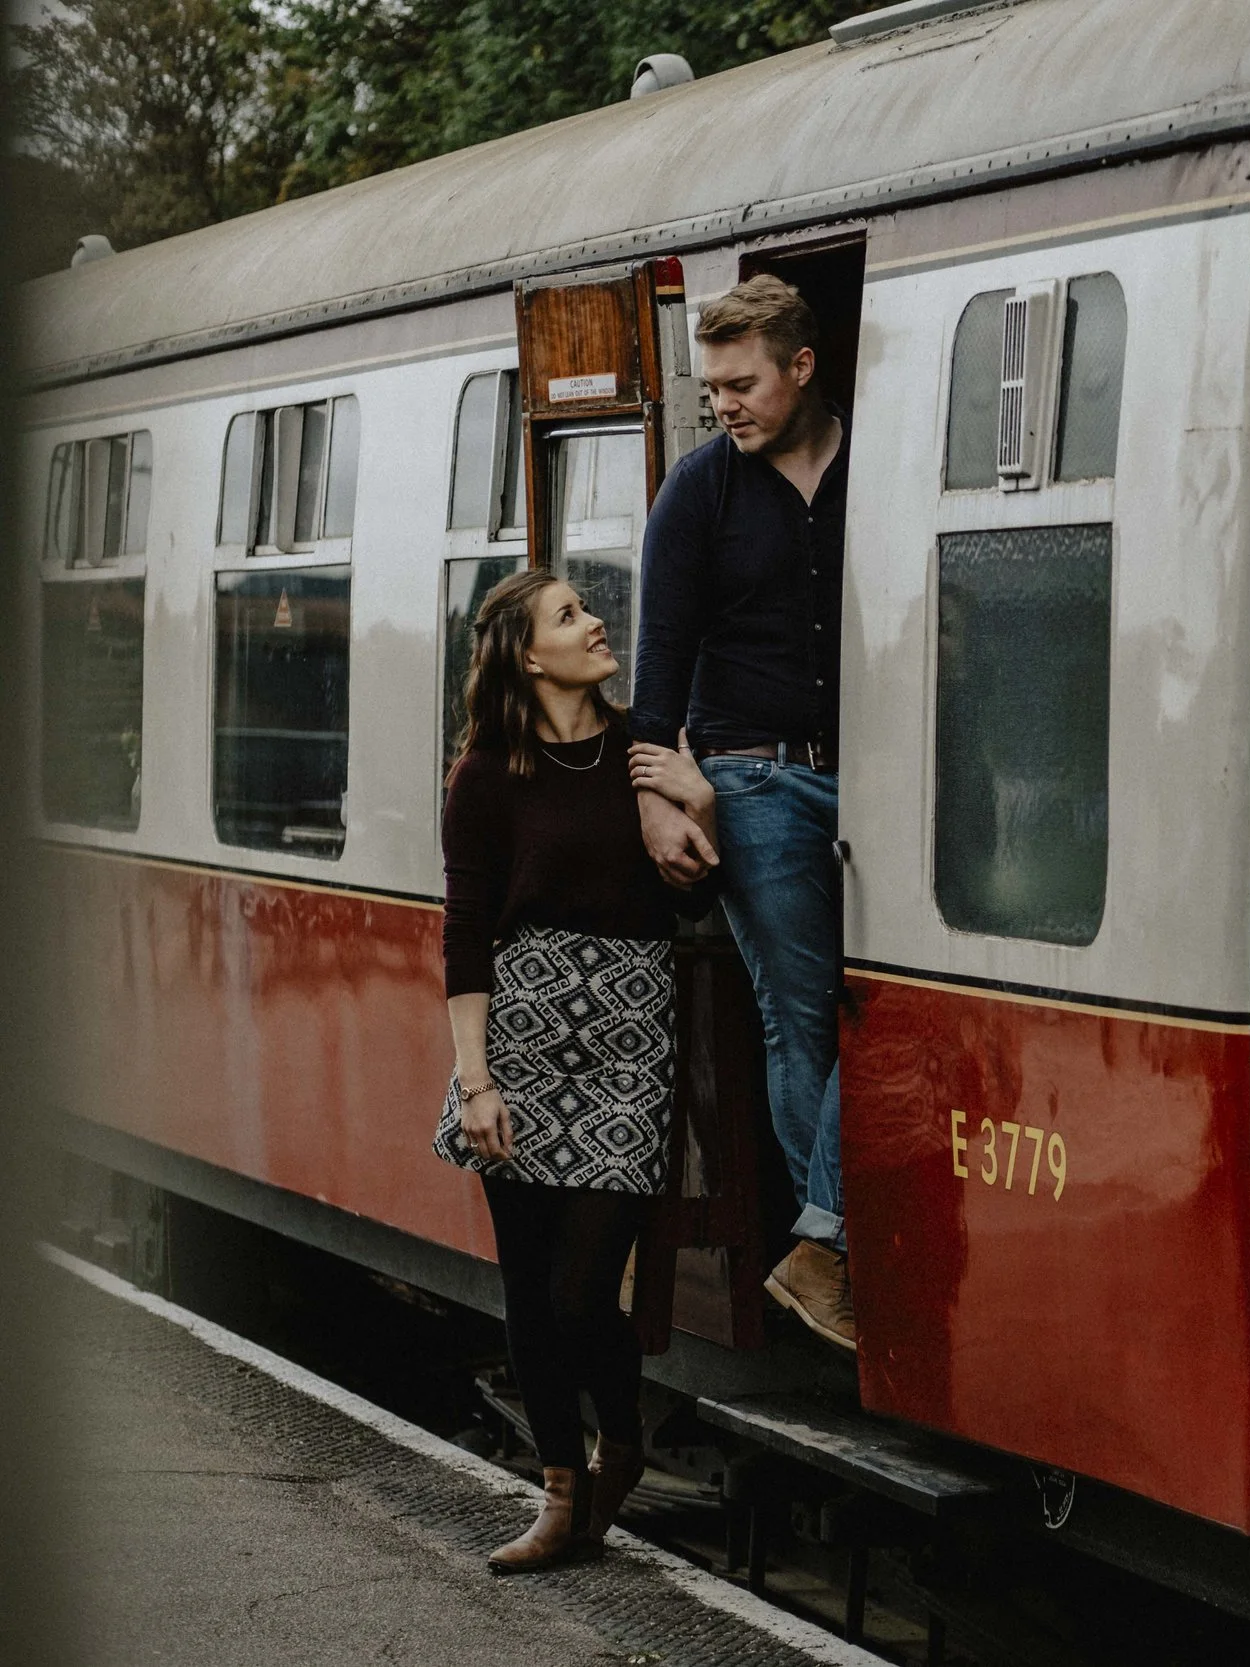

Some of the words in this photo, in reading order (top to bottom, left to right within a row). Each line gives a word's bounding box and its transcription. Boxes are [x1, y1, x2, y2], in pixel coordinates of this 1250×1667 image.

[570, 378, 593, 388] CAUTION
[951, 1109, 968, 1179] E
[980, 1117, 1067, 1202] 3779
